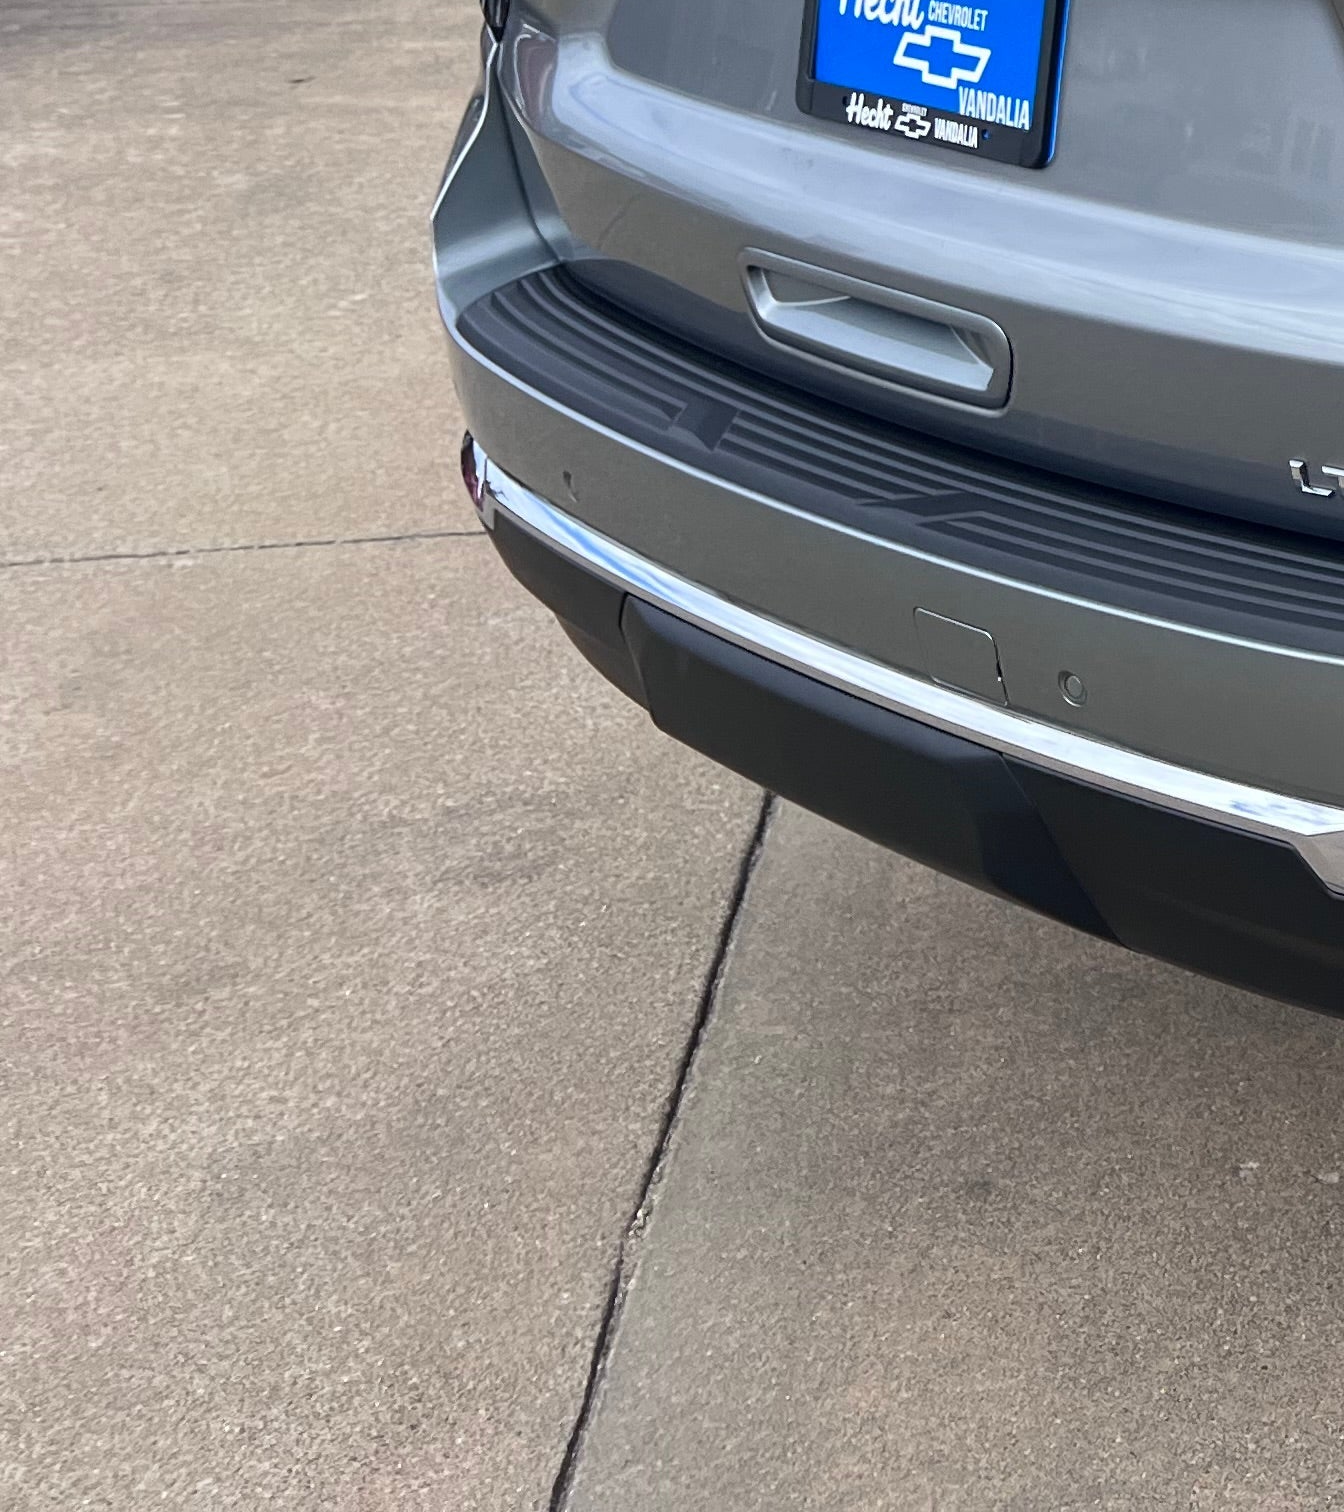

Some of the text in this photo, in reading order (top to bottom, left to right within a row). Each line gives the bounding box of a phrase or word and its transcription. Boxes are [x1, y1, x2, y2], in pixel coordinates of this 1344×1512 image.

[928, 0, 988, 31] CHEVROLET
[846, 92, 894, 130] Hecht
[958, 86, 1030, 130] VANDALIA
[934, 118, 978, 148] VANDALIA
